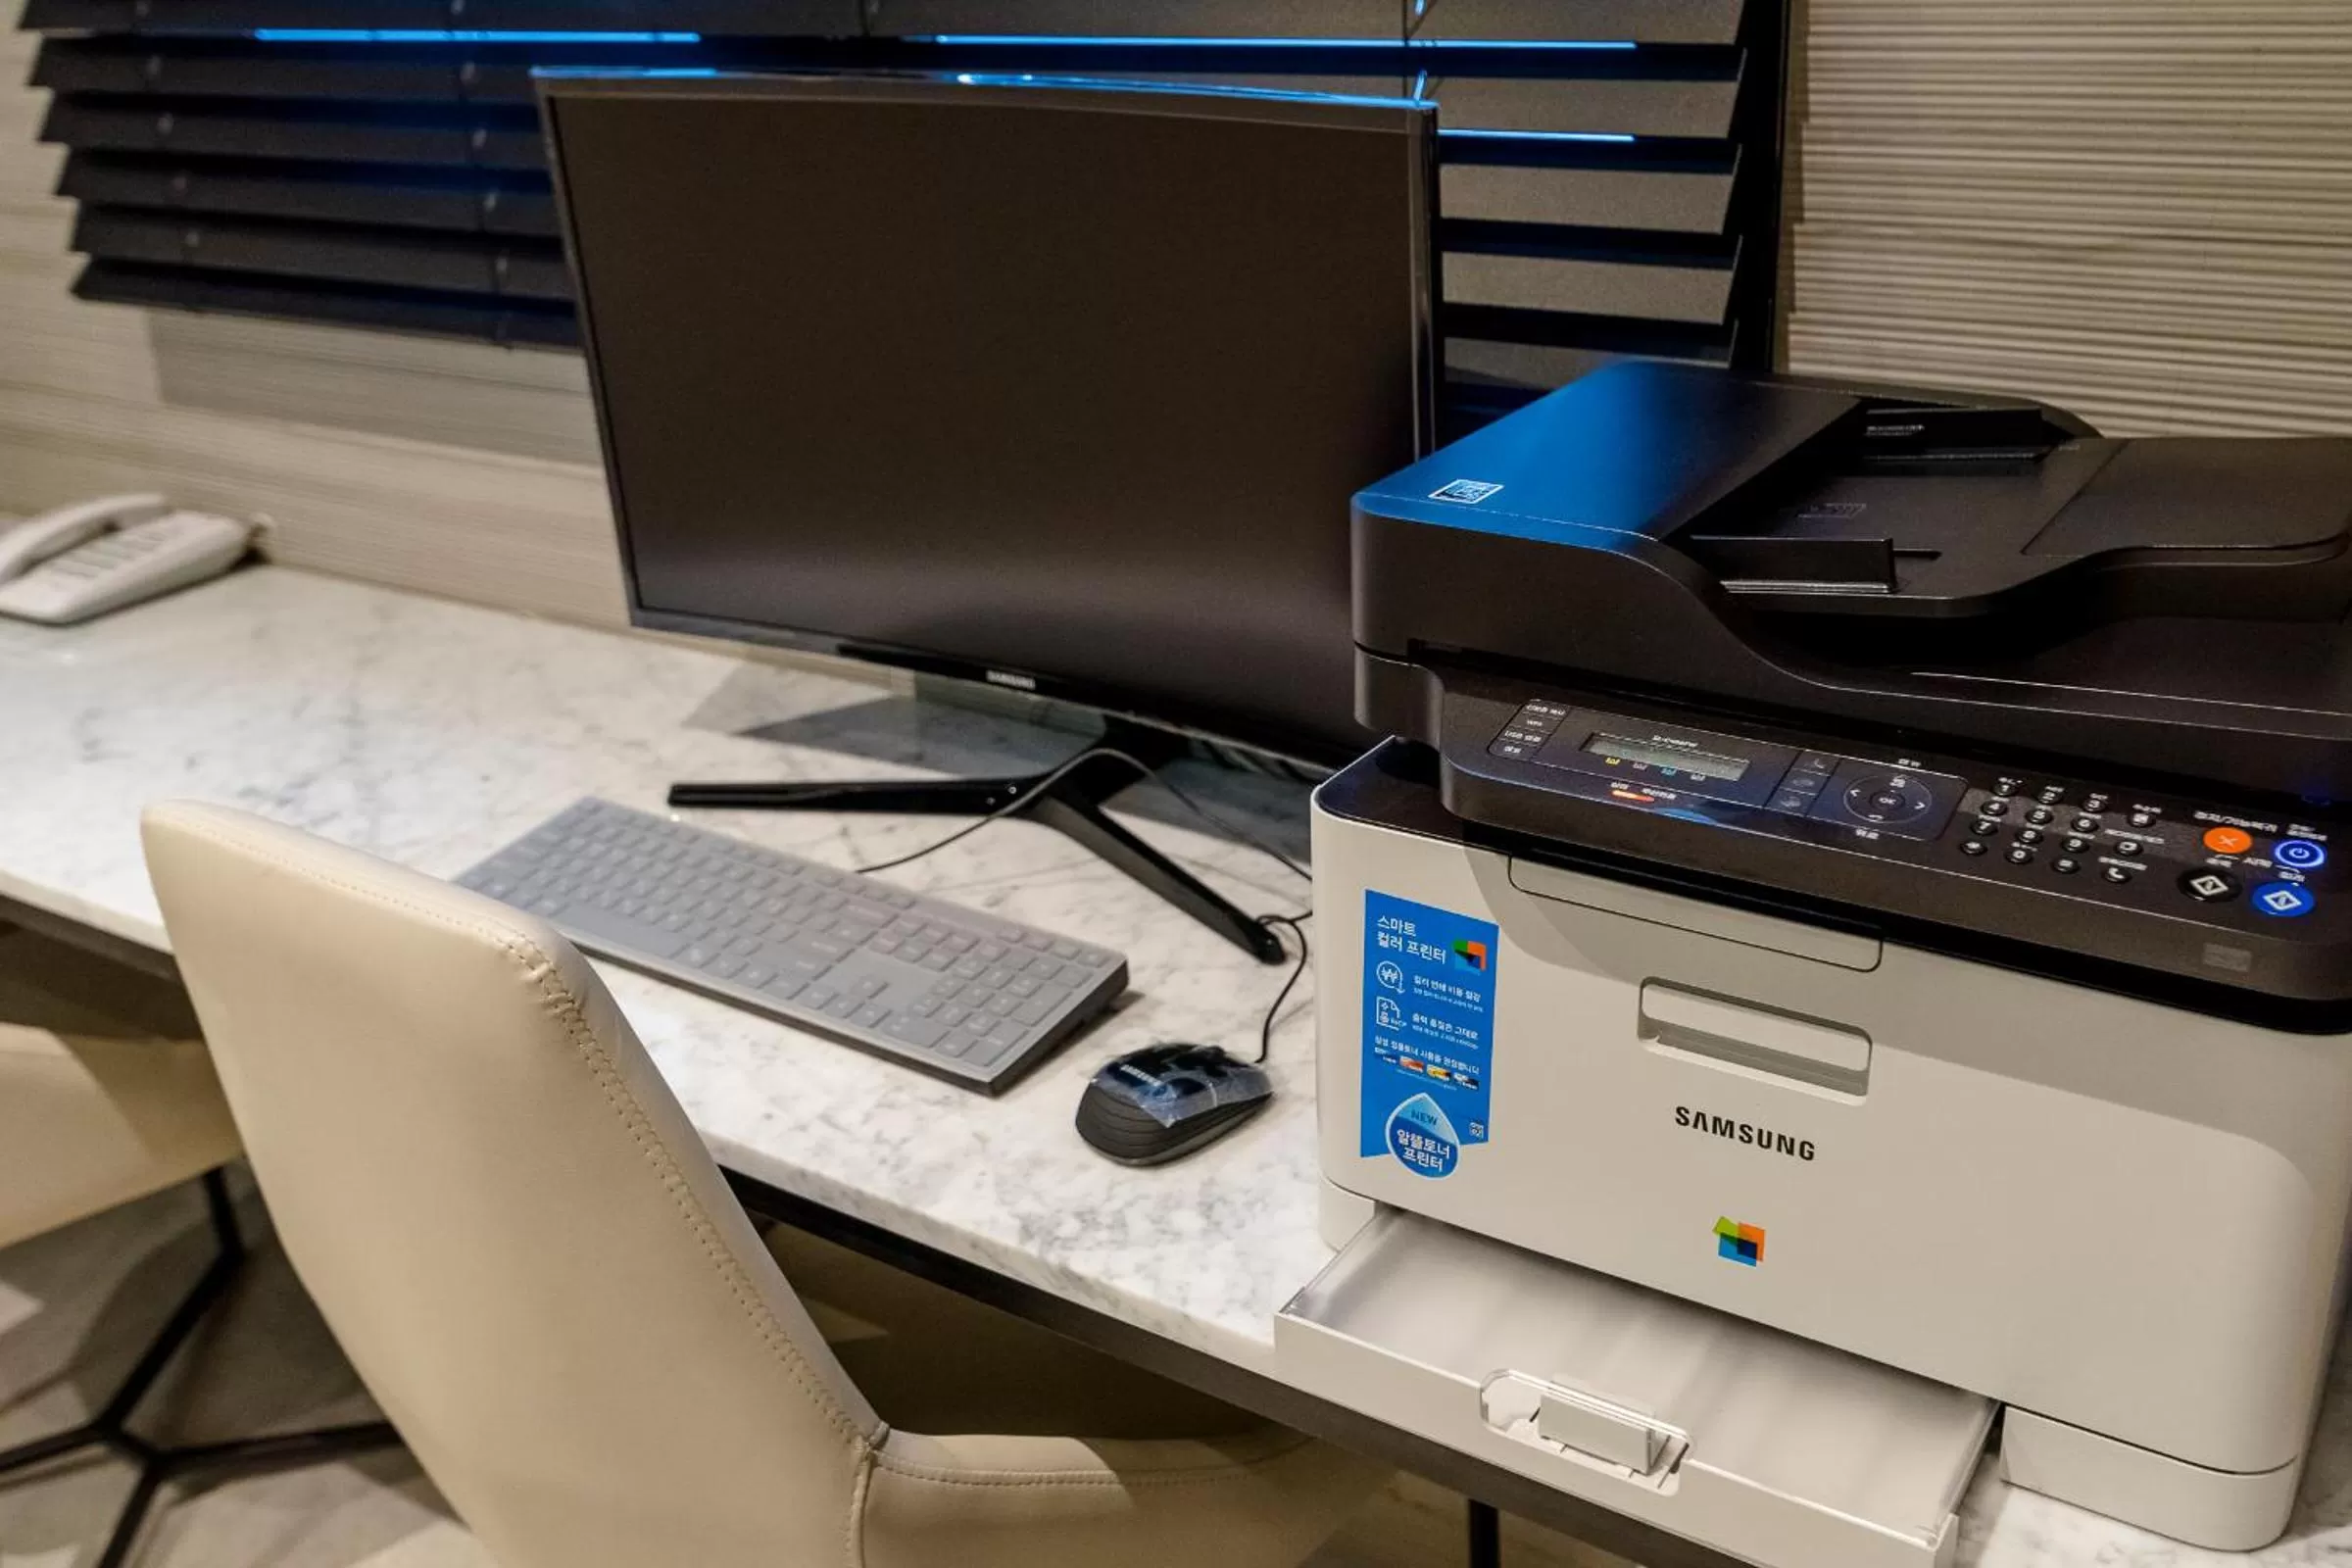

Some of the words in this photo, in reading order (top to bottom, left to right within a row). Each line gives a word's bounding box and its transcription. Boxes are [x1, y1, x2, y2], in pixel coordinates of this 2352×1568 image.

[1377, 915, 1417, 937] 스마트
[1377, 931, 1402, 952] 컬러
[1406, 940, 1446, 964] 프린터
[1410, 1108, 1439, 1127] NEW
[1675, 1105, 1816, 1161] SAMSUNG
[1402, 1147, 1444, 1173] 프린터
